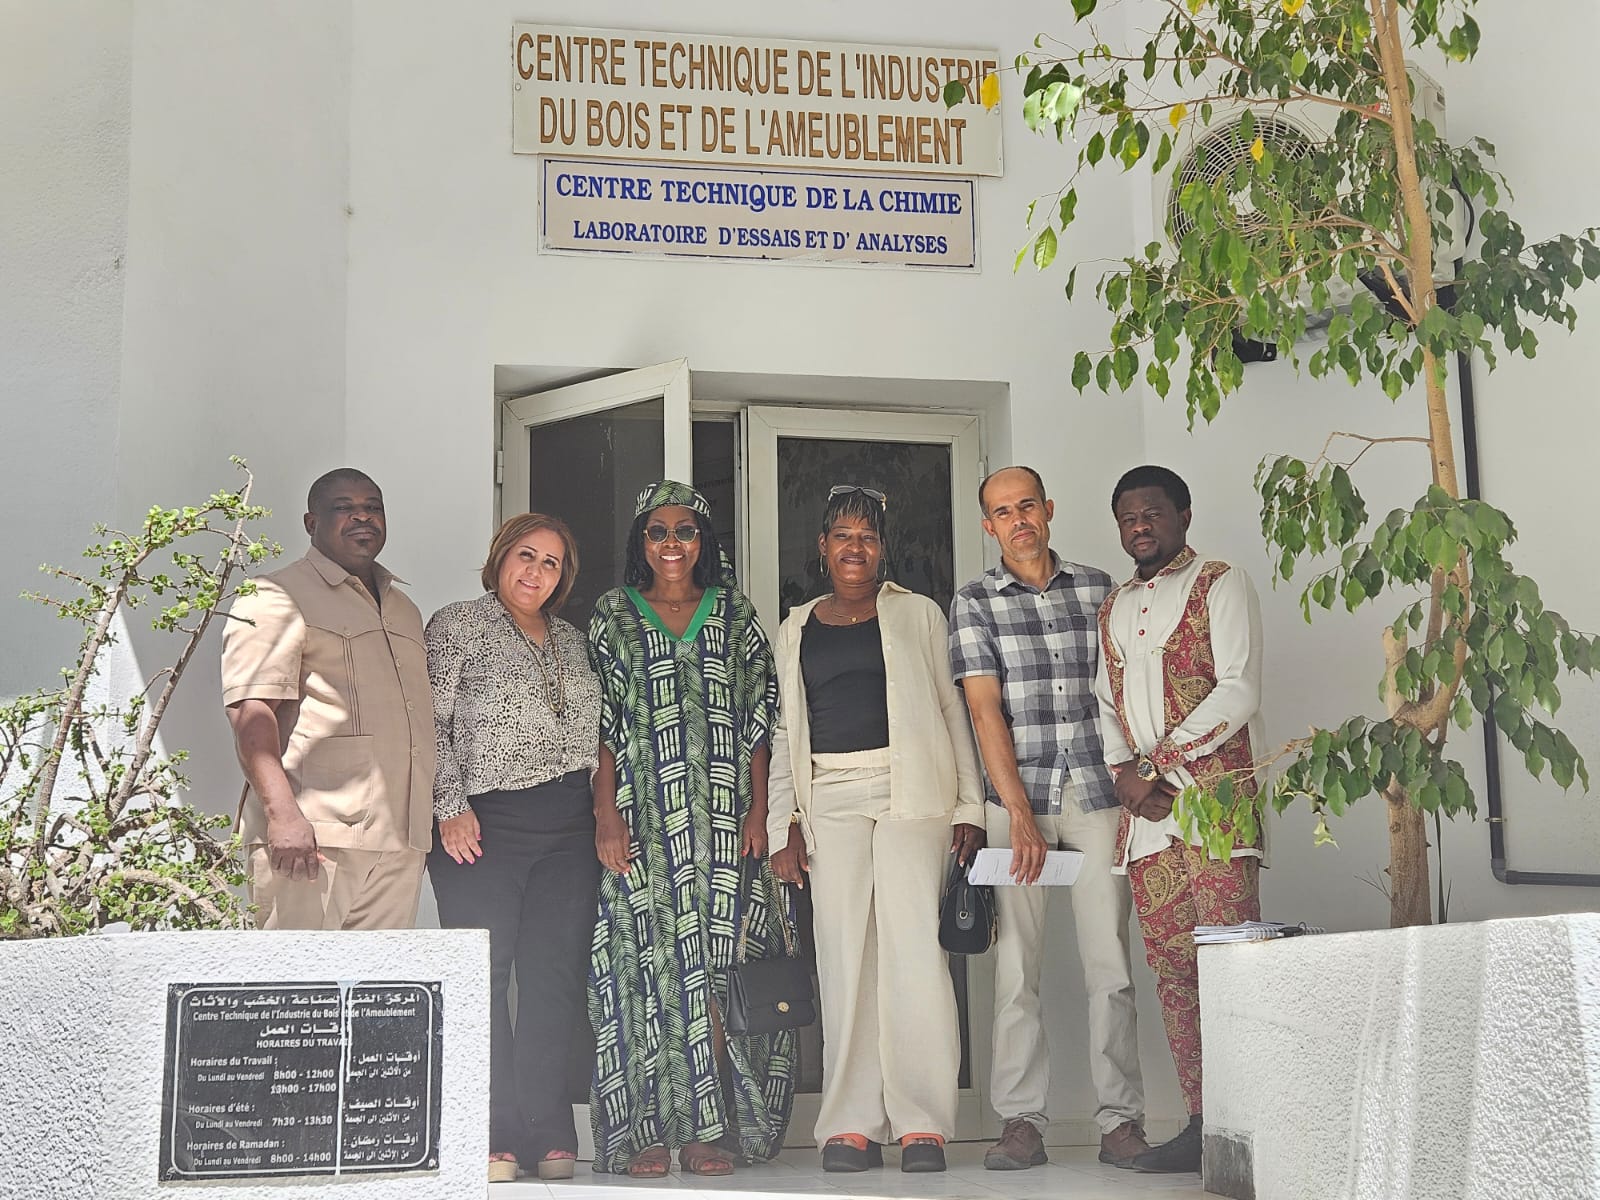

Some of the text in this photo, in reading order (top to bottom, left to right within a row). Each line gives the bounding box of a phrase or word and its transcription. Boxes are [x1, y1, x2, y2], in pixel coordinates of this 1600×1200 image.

[516, 32, 627, 86] CENTRE
[634, 40, 789, 97] TECHNIQUE
[797, 49, 832, 97] DE
[540, 96, 967, 166] DU BOIS ET DE L'AMEUBLEMENT
[556, 173, 962, 215] CENTRE TECHNIQUE DE LA CHIMIE
[573, 220, 948, 255] LABORATOIRE D'ESSAIS ET D' ANALYSES
[244, 994, 285, 1008] الخشب
[347, 992, 380, 1006] الفن
[385, 992, 420, 1005] المركز
[193, 1011, 218, 1021] Centre
[220, 1010, 259, 1022] Technique
[260, 1010, 270, 1020] de
[271, 1008, 310, 1019] l'Industrie
[312, 1009, 321, 1019] du
[323, 1008, 339, 1018] Bois
[361, 1007, 416, 1018] l'Ameublement
[260, 1024, 295, 1038] العمل
[256, 1039, 301, 1049] HORAIRES
[302, 1039, 315, 1048] DU
[190, 1056, 228, 1067] Horaires
[229, 1056, 241, 1066] du
[242, 1055, 273, 1066] Travail
[358, 1053, 383, 1065] العمل
[197, 1073, 207, 1082] Du
[207, 1072, 227, 1082] Lundi
[227, 1073, 236, 1081] au
[236, 1071, 265, 1081] Vendredi
[273, 1070, 297, 1080] 8h00
[306, 1069, 334, 1079] 12h00
[270, 1084, 299, 1095] 13h00
[308, 1082, 337, 1093] 17h00
[188, 1103, 226, 1114] Horaires
[227, 1102, 250, 1113] d'été
[348, 1098, 381, 1111] الصيف
[195, 1121, 205, 1129] Du
[205, 1120, 224, 1129] Lundi
[234, 1118, 263, 1128] Vendredi
[271, 1116, 295, 1127] 7h30
[304, 1115, 333, 1126] 13h30
[186, 1141, 224, 1151] Horaires
[226, 1140, 238, 1150] de
[239, 1138, 280, 1149] Ramadan
[350, 1135, 380, 1149] رمضان
[193, 1158, 203, 1166] Du
[203, 1157, 222, 1166] Lundi
[232, 1155, 262, 1165] Vendredi
[270, 1154, 294, 1164] 8h00
[303, 1151, 332, 1162] 14h00
